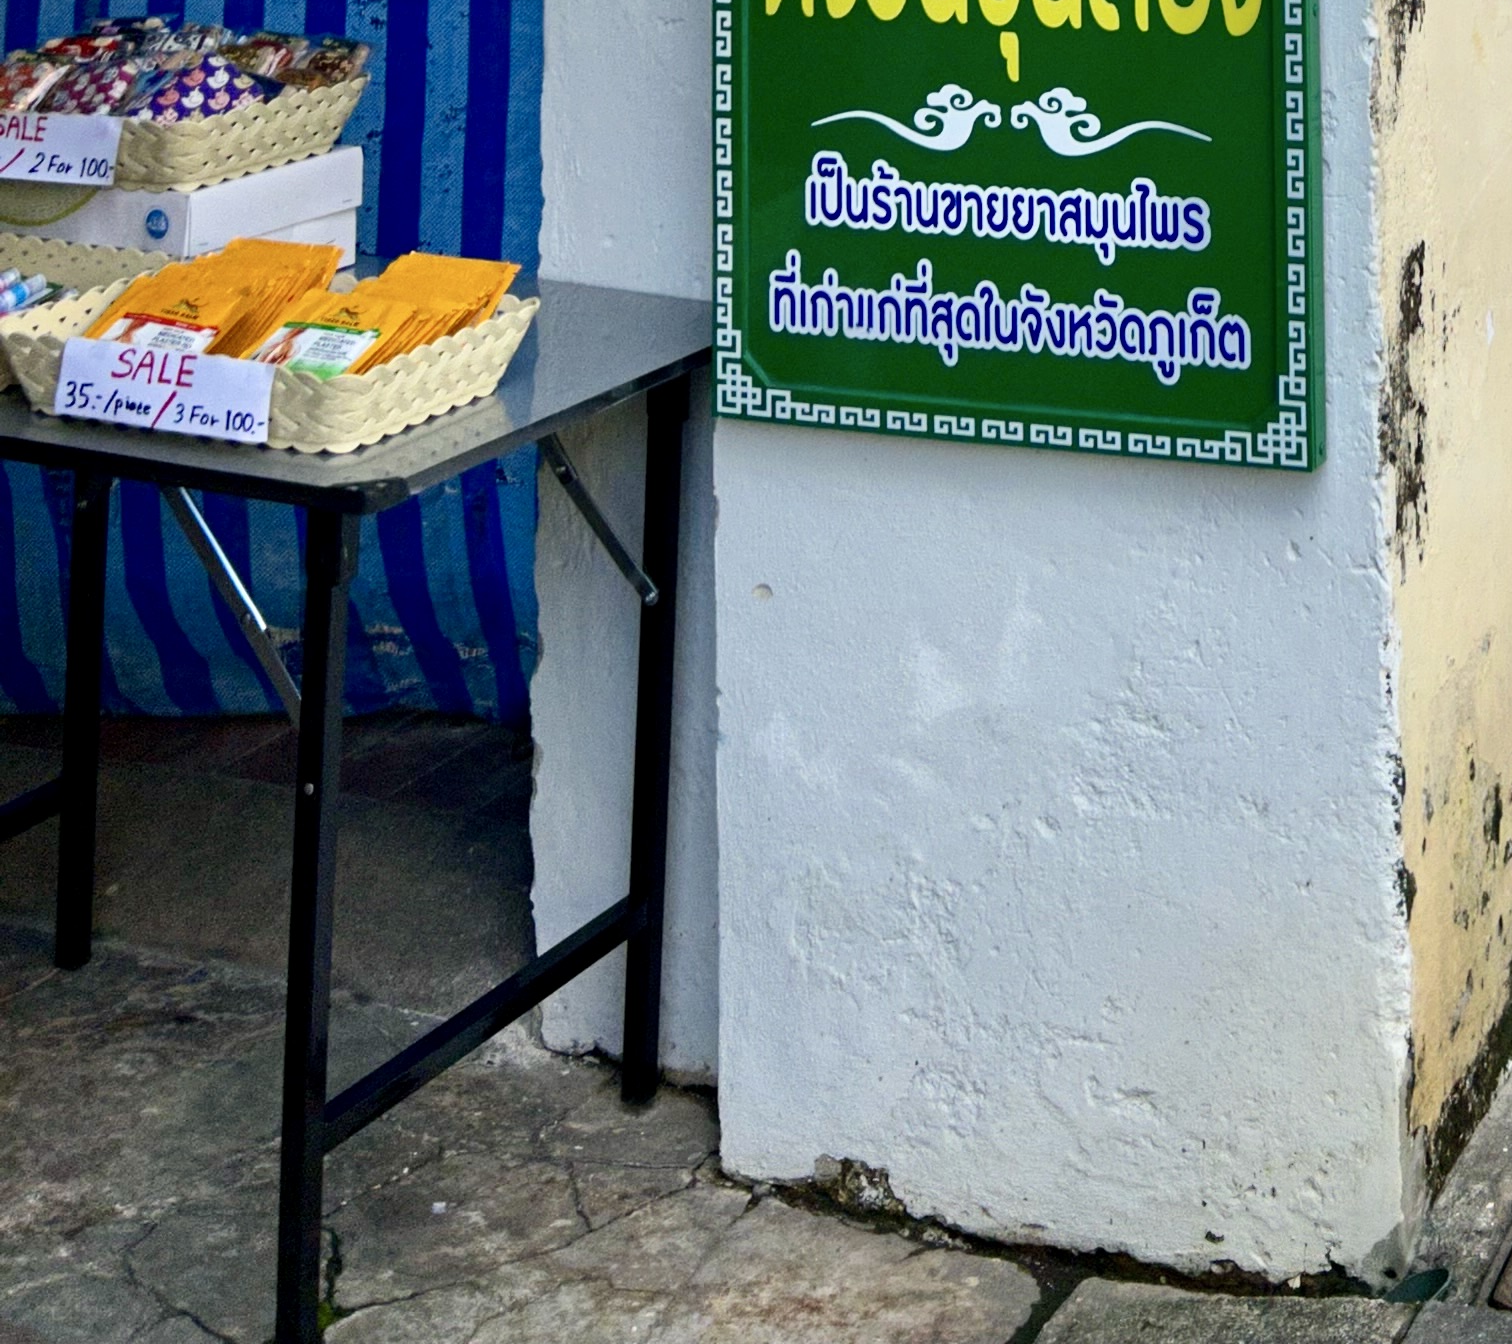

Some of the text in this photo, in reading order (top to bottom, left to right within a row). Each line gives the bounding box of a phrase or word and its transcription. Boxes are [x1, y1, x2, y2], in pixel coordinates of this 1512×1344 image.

[28, 151, 46, 174] 2
[47, 154, 73, 175] For
[804, 150, 1211, 265] เป็นร้านขายยาสมุนไพร
[769, 250, 1252, 385] ที่เก่าแก่ที่สุดในจังหวัดภูเก็ต
[110, 347, 198, 388] SALE
[173, 403, 185, 424] 3
[189, 405, 220, 427] For
